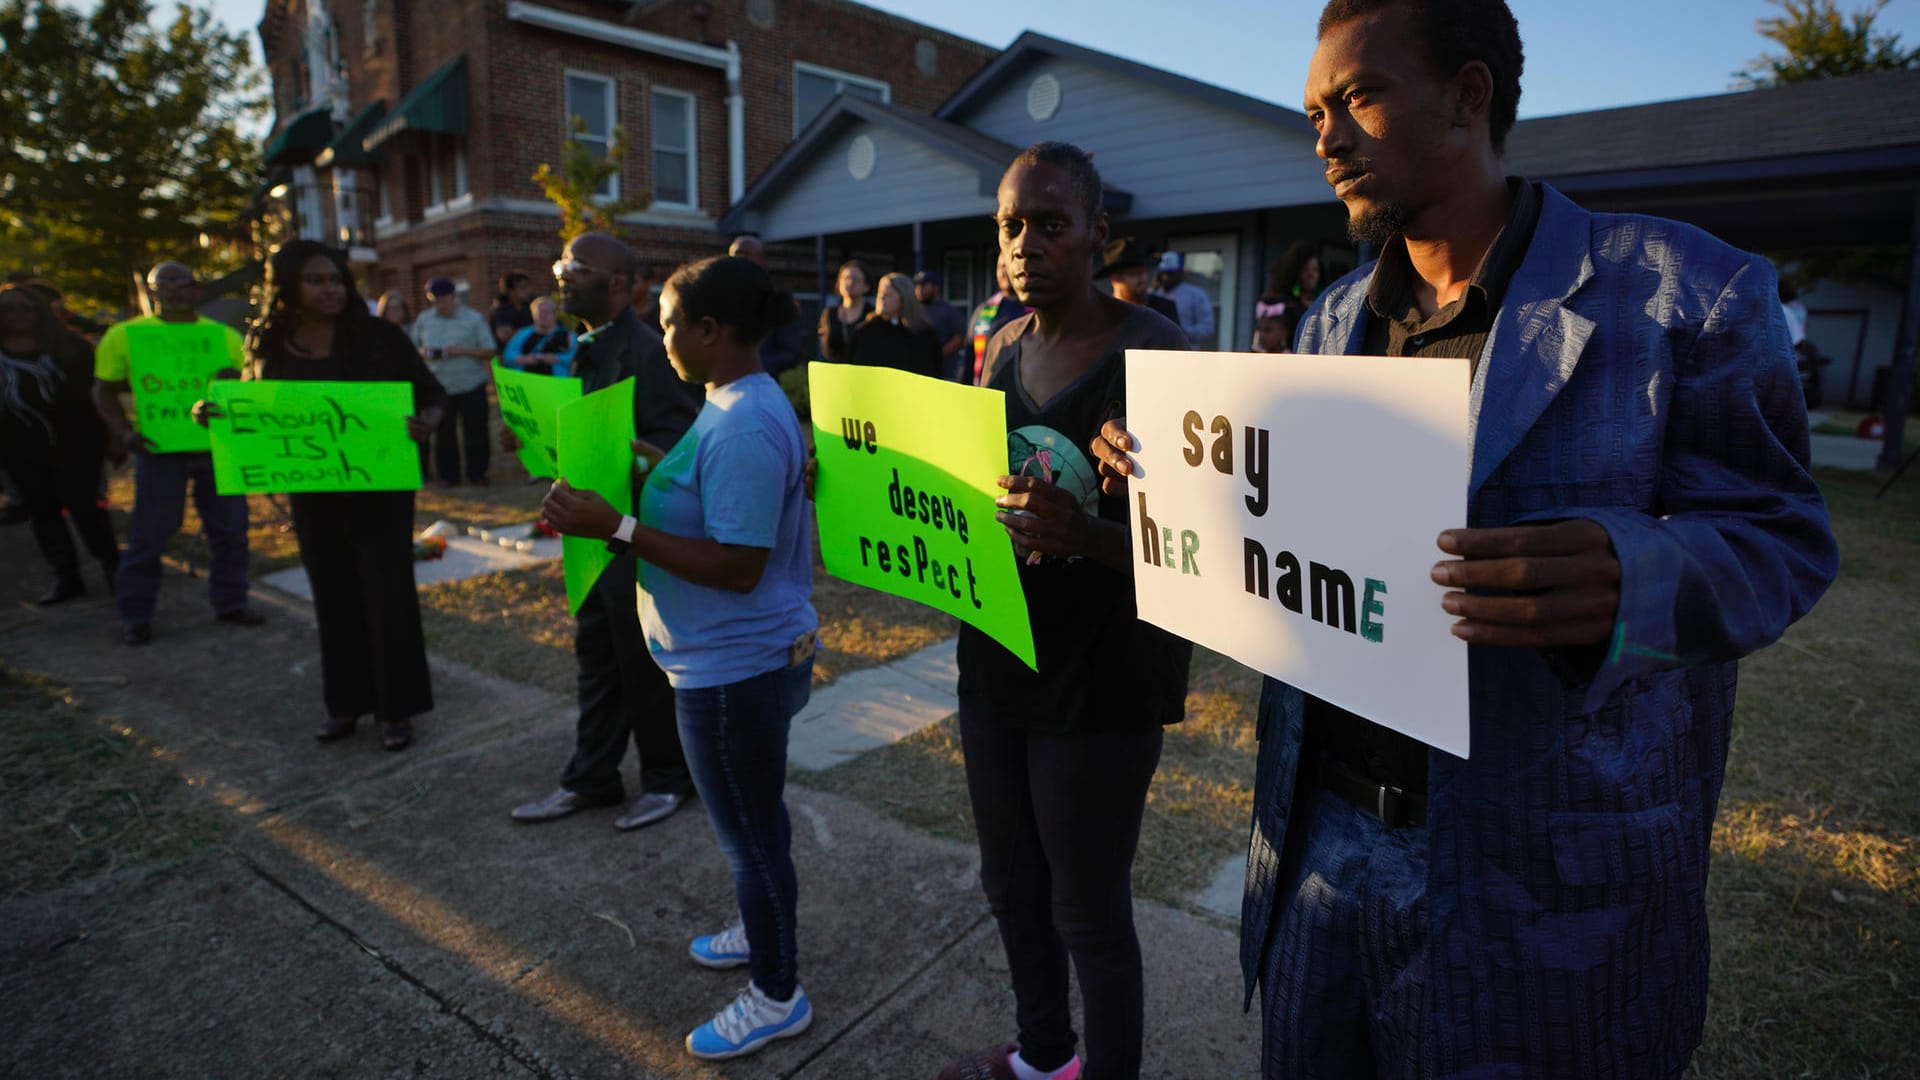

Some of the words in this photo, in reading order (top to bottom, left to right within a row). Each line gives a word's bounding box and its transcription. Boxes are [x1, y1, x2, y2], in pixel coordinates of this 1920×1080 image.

[228, 395, 368, 443] Enough
[841, 417, 877, 455] we
[240, 448, 372, 487] Enough
[268, 434, 327, 460] IS
[1182, 410, 1270, 518] say
[1137, 492, 1201, 577] hER
[1243, 537, 1388, 643] namE
